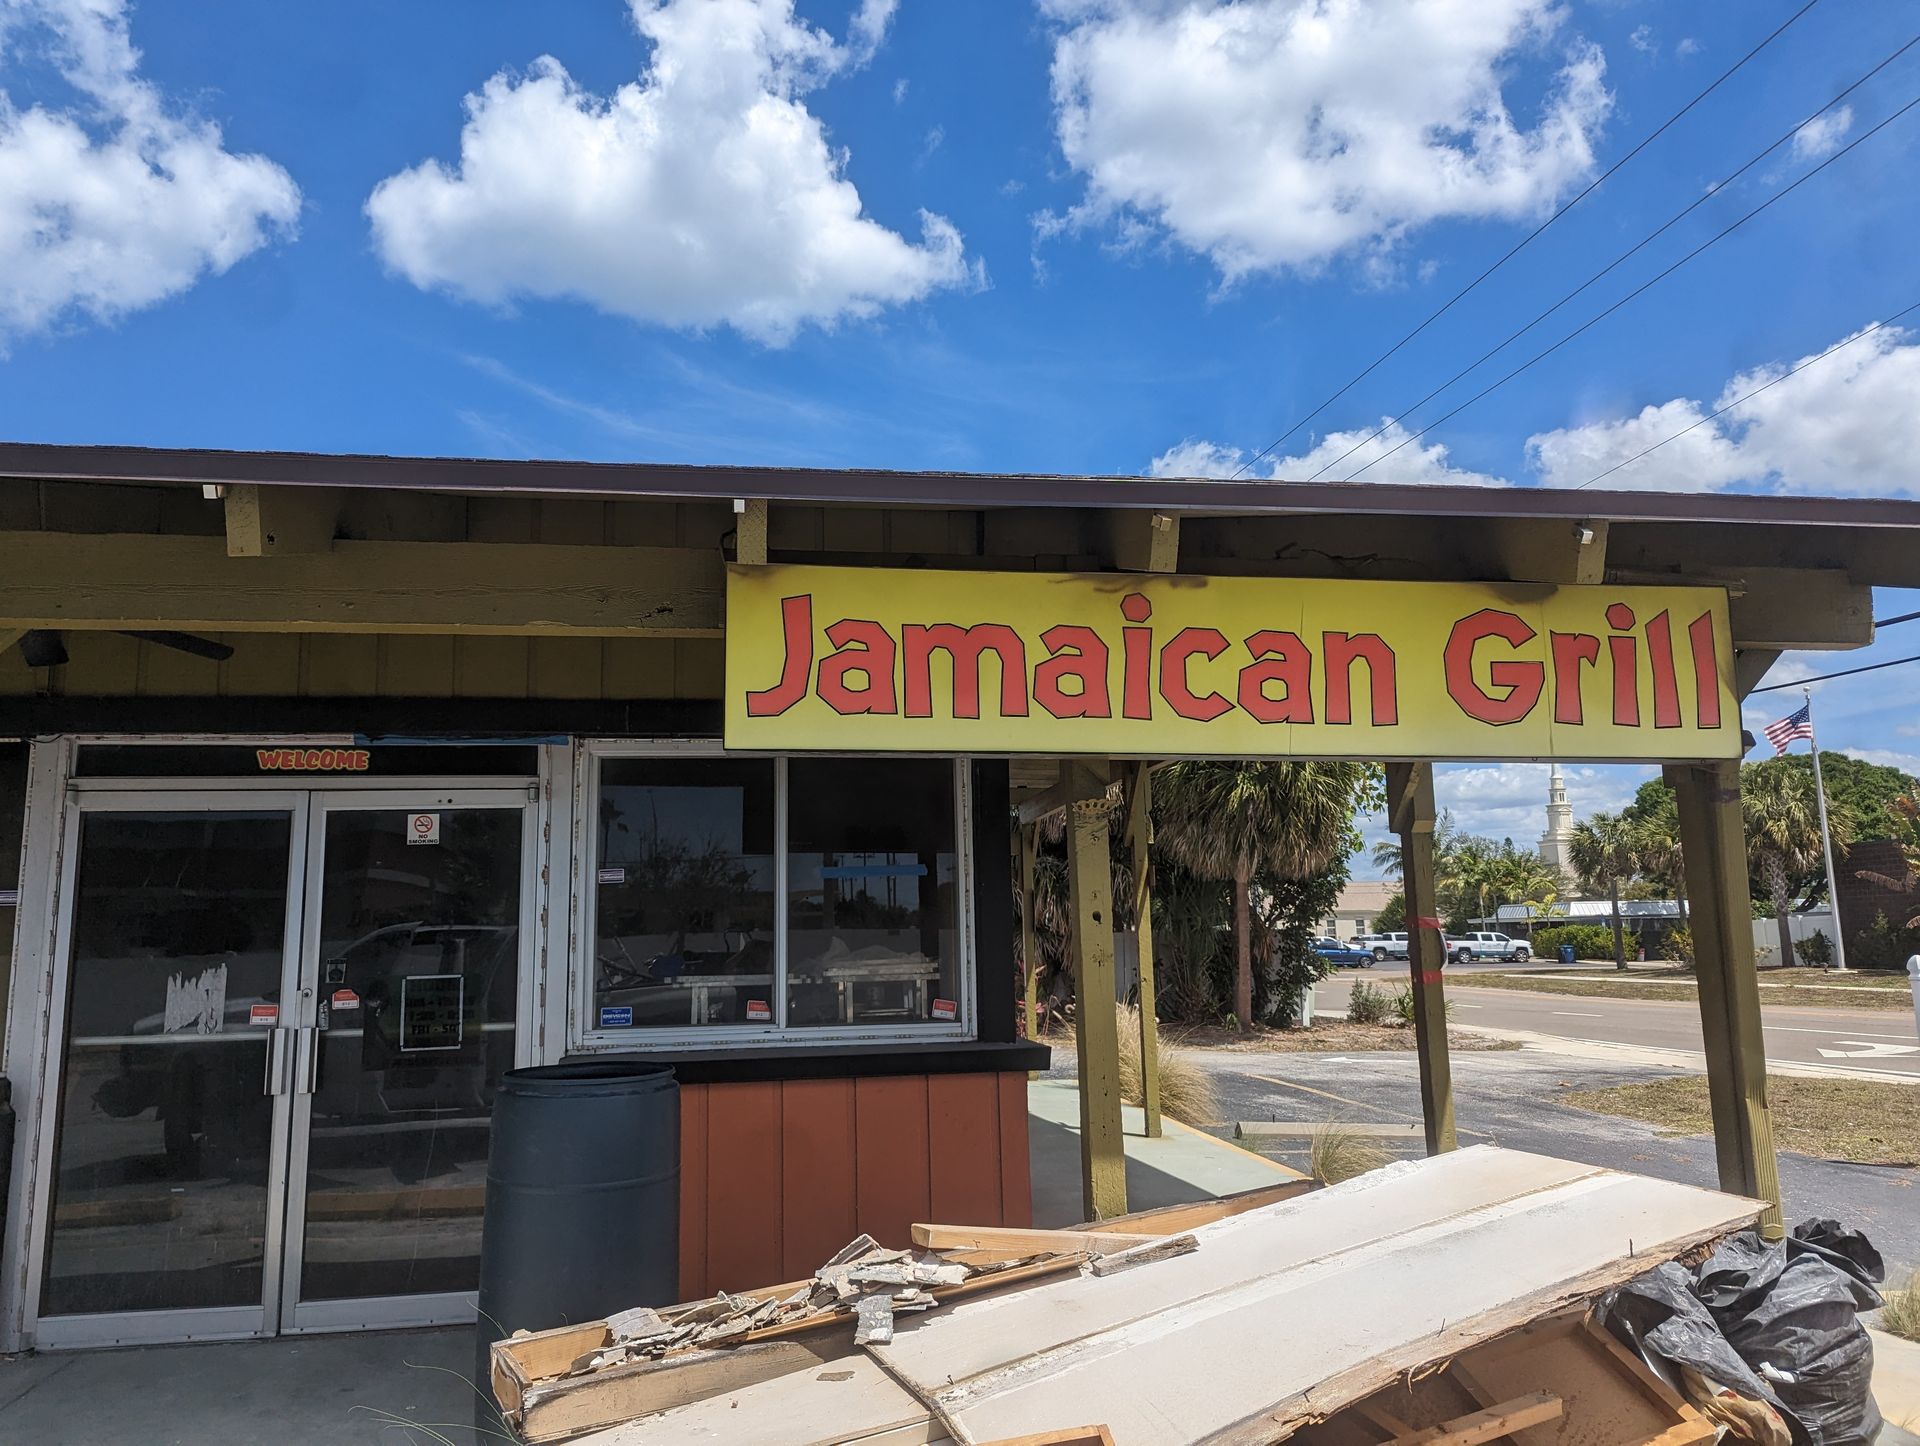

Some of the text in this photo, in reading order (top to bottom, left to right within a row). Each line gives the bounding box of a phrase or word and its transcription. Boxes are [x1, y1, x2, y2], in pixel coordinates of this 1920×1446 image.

[746, 592, 1722, 730] Jamaican Grill
[257, 749, 370, 770] WELCOME
